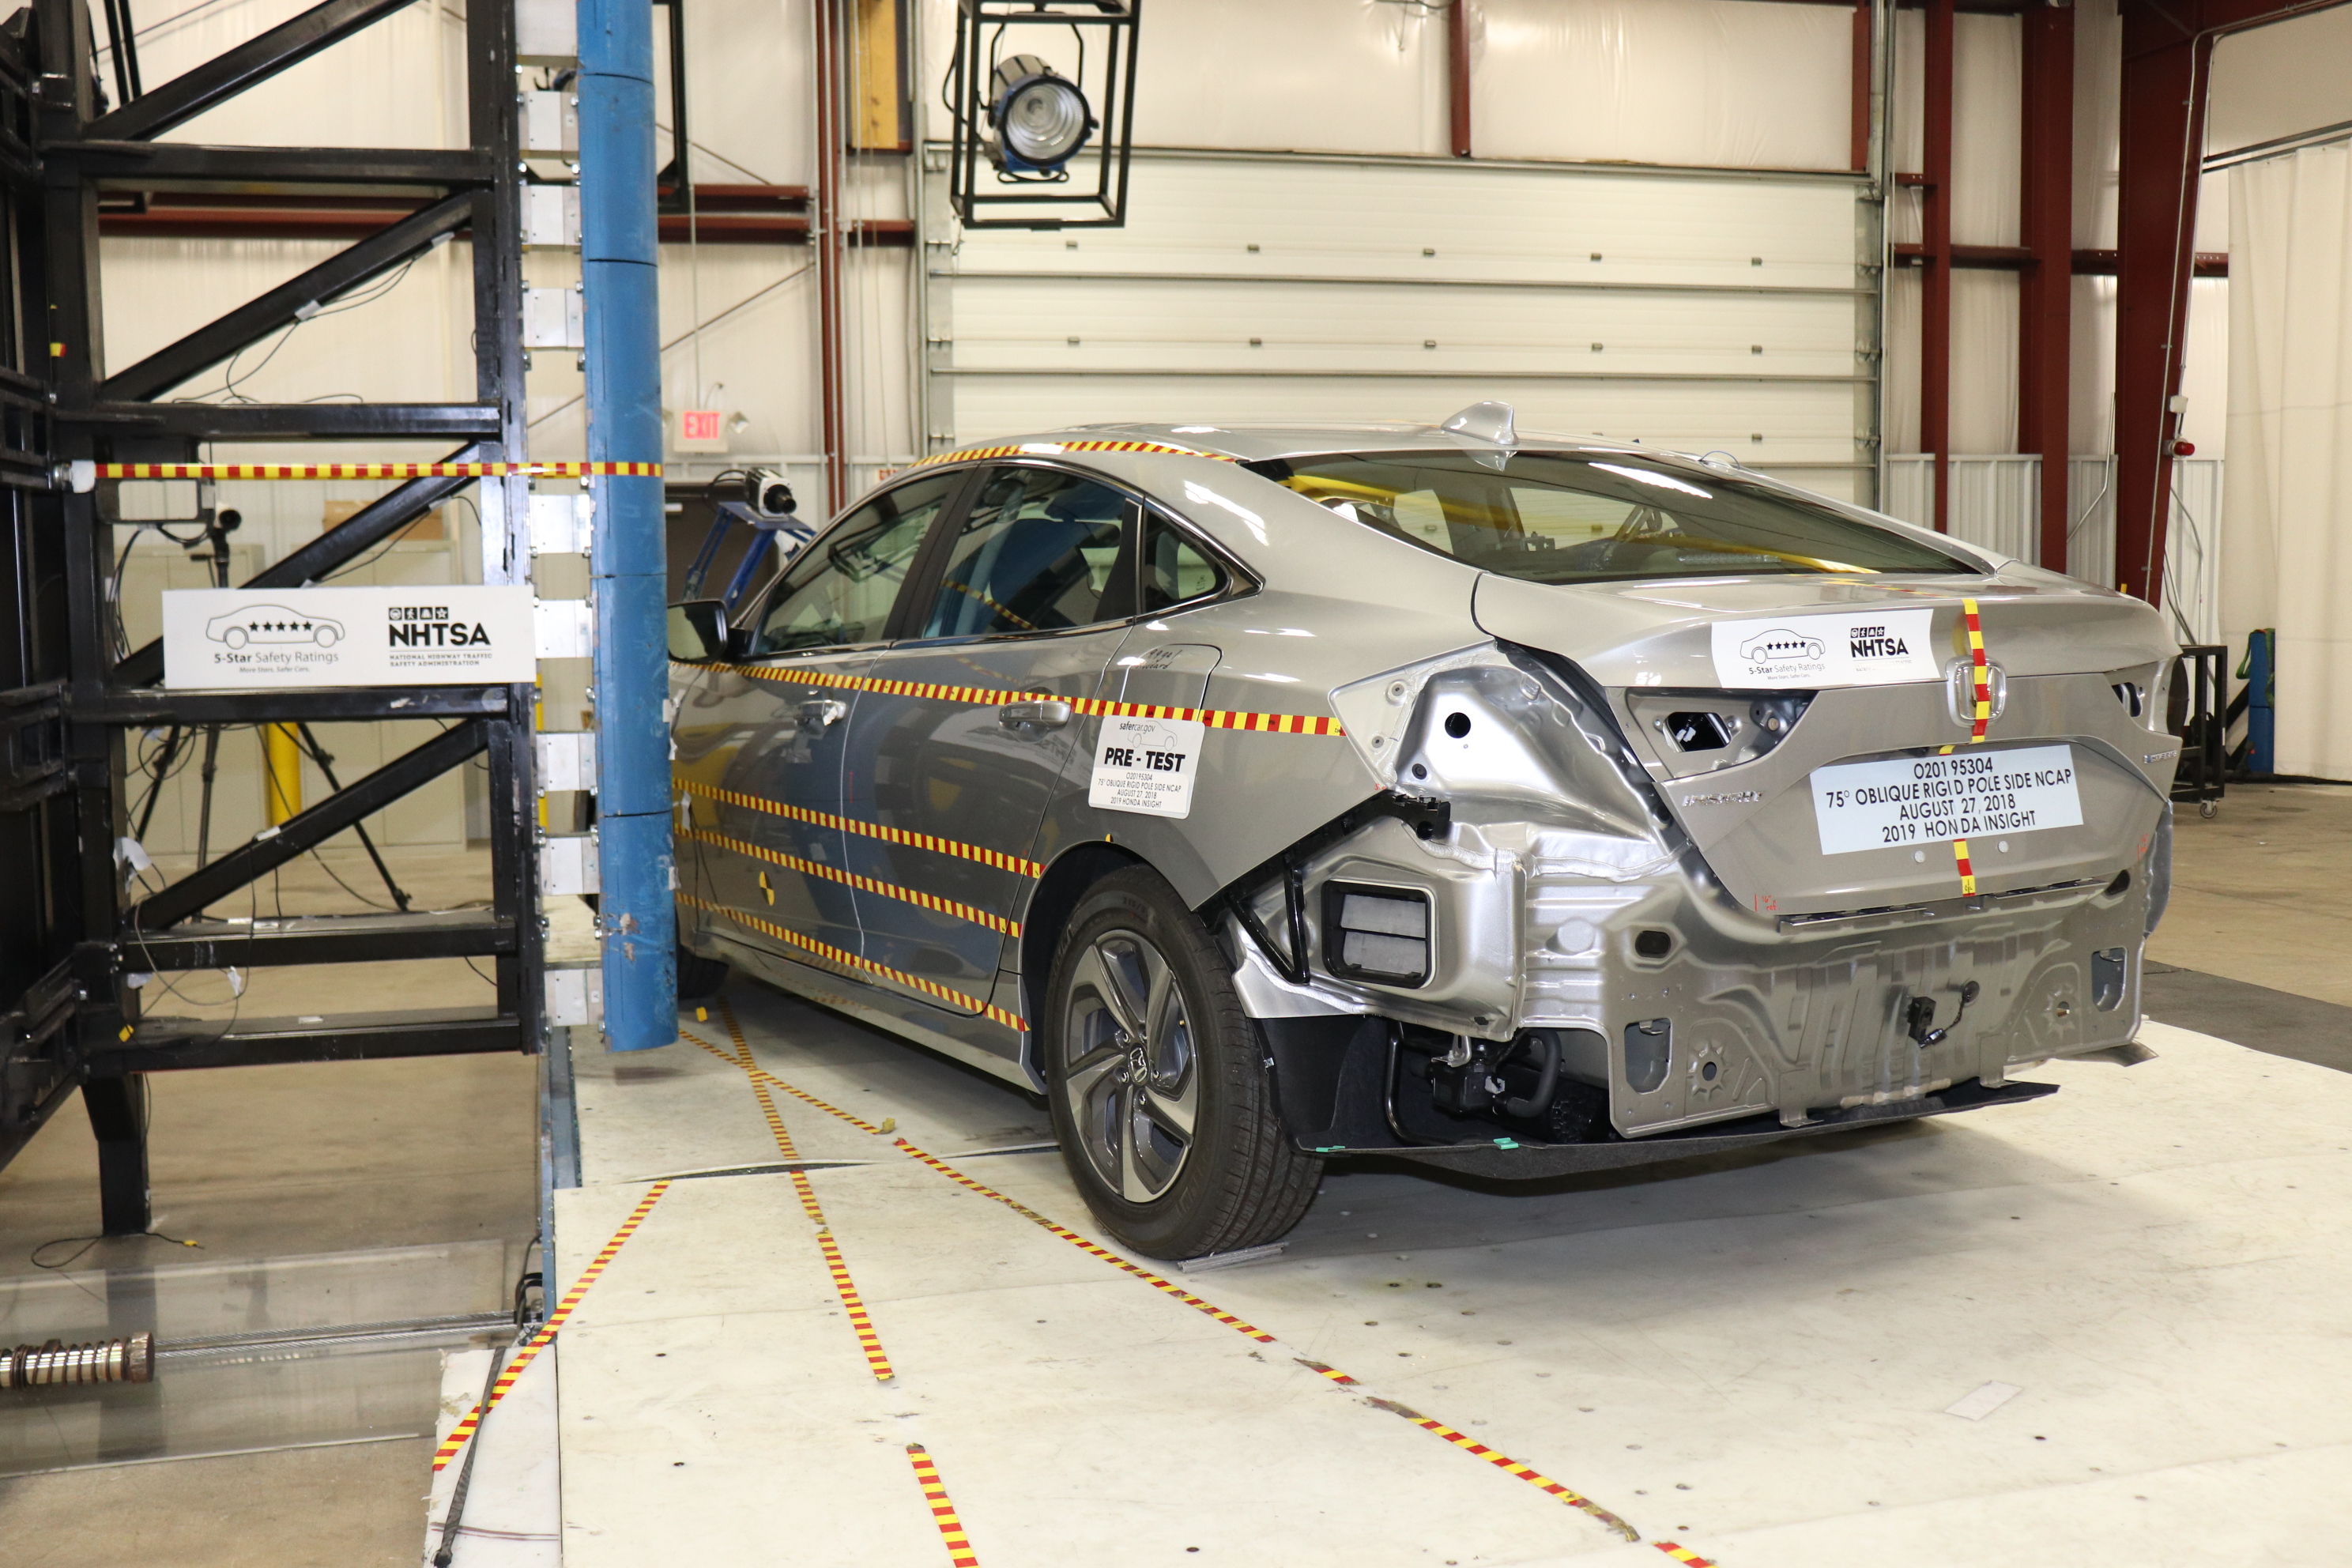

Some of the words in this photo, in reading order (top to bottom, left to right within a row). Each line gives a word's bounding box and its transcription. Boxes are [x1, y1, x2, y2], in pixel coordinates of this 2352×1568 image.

[683, 411, 721, 439] EXIT
[389, 623, 491, 646] NHTSA
[214, 653, 252, 663] 5-Star
[255, 651, 292, 665] Safety
[295, 651, 339, 664] Ratings
[1850, 638, 1909, 658] NHTSA
[1749, 665, 1773, 675] 5-Star
[1774, 664, 1797, 673] Safety
[1798, 662, 1826, 672] Ratings
[1120, 721, 1155, 733] safercar.gov
[1104, 747, 1134, 767] PRE
[1146, 751, 1185, 772] TEST
[1106, 779, 1126, 788] OBLIQUE
[1126, 781, 1140, 790] RIGID
[1140, 782, 1154, 790] POLE
[1166, 784, 1182, 793] NCAP
[1117, 789, 1136, 797] AUGUST
[1826, 790, 1850, 808] 75°
[1856, 785, 1920, 805] OBLIQUE
[1924, 779, 1963, 798] RIGID
[1968, 775, 2001, 795] POLE
[2004, 772, 2032, 790] SIDE
[2035, 768, 2072, 788] NCAP
[1122, 798, 1140, 807] HONDA
[1141, 800, 1162, 808] INSIGHT
[1899, 800, 1954, 820] AUGUST
[1984, 793, 2016, 812] 2018
[1883, 824, 1916, 843] 2019
[1925, 818, 1981, 839] HONDA
[1984, 810, 2036, 830] INSIGHT
